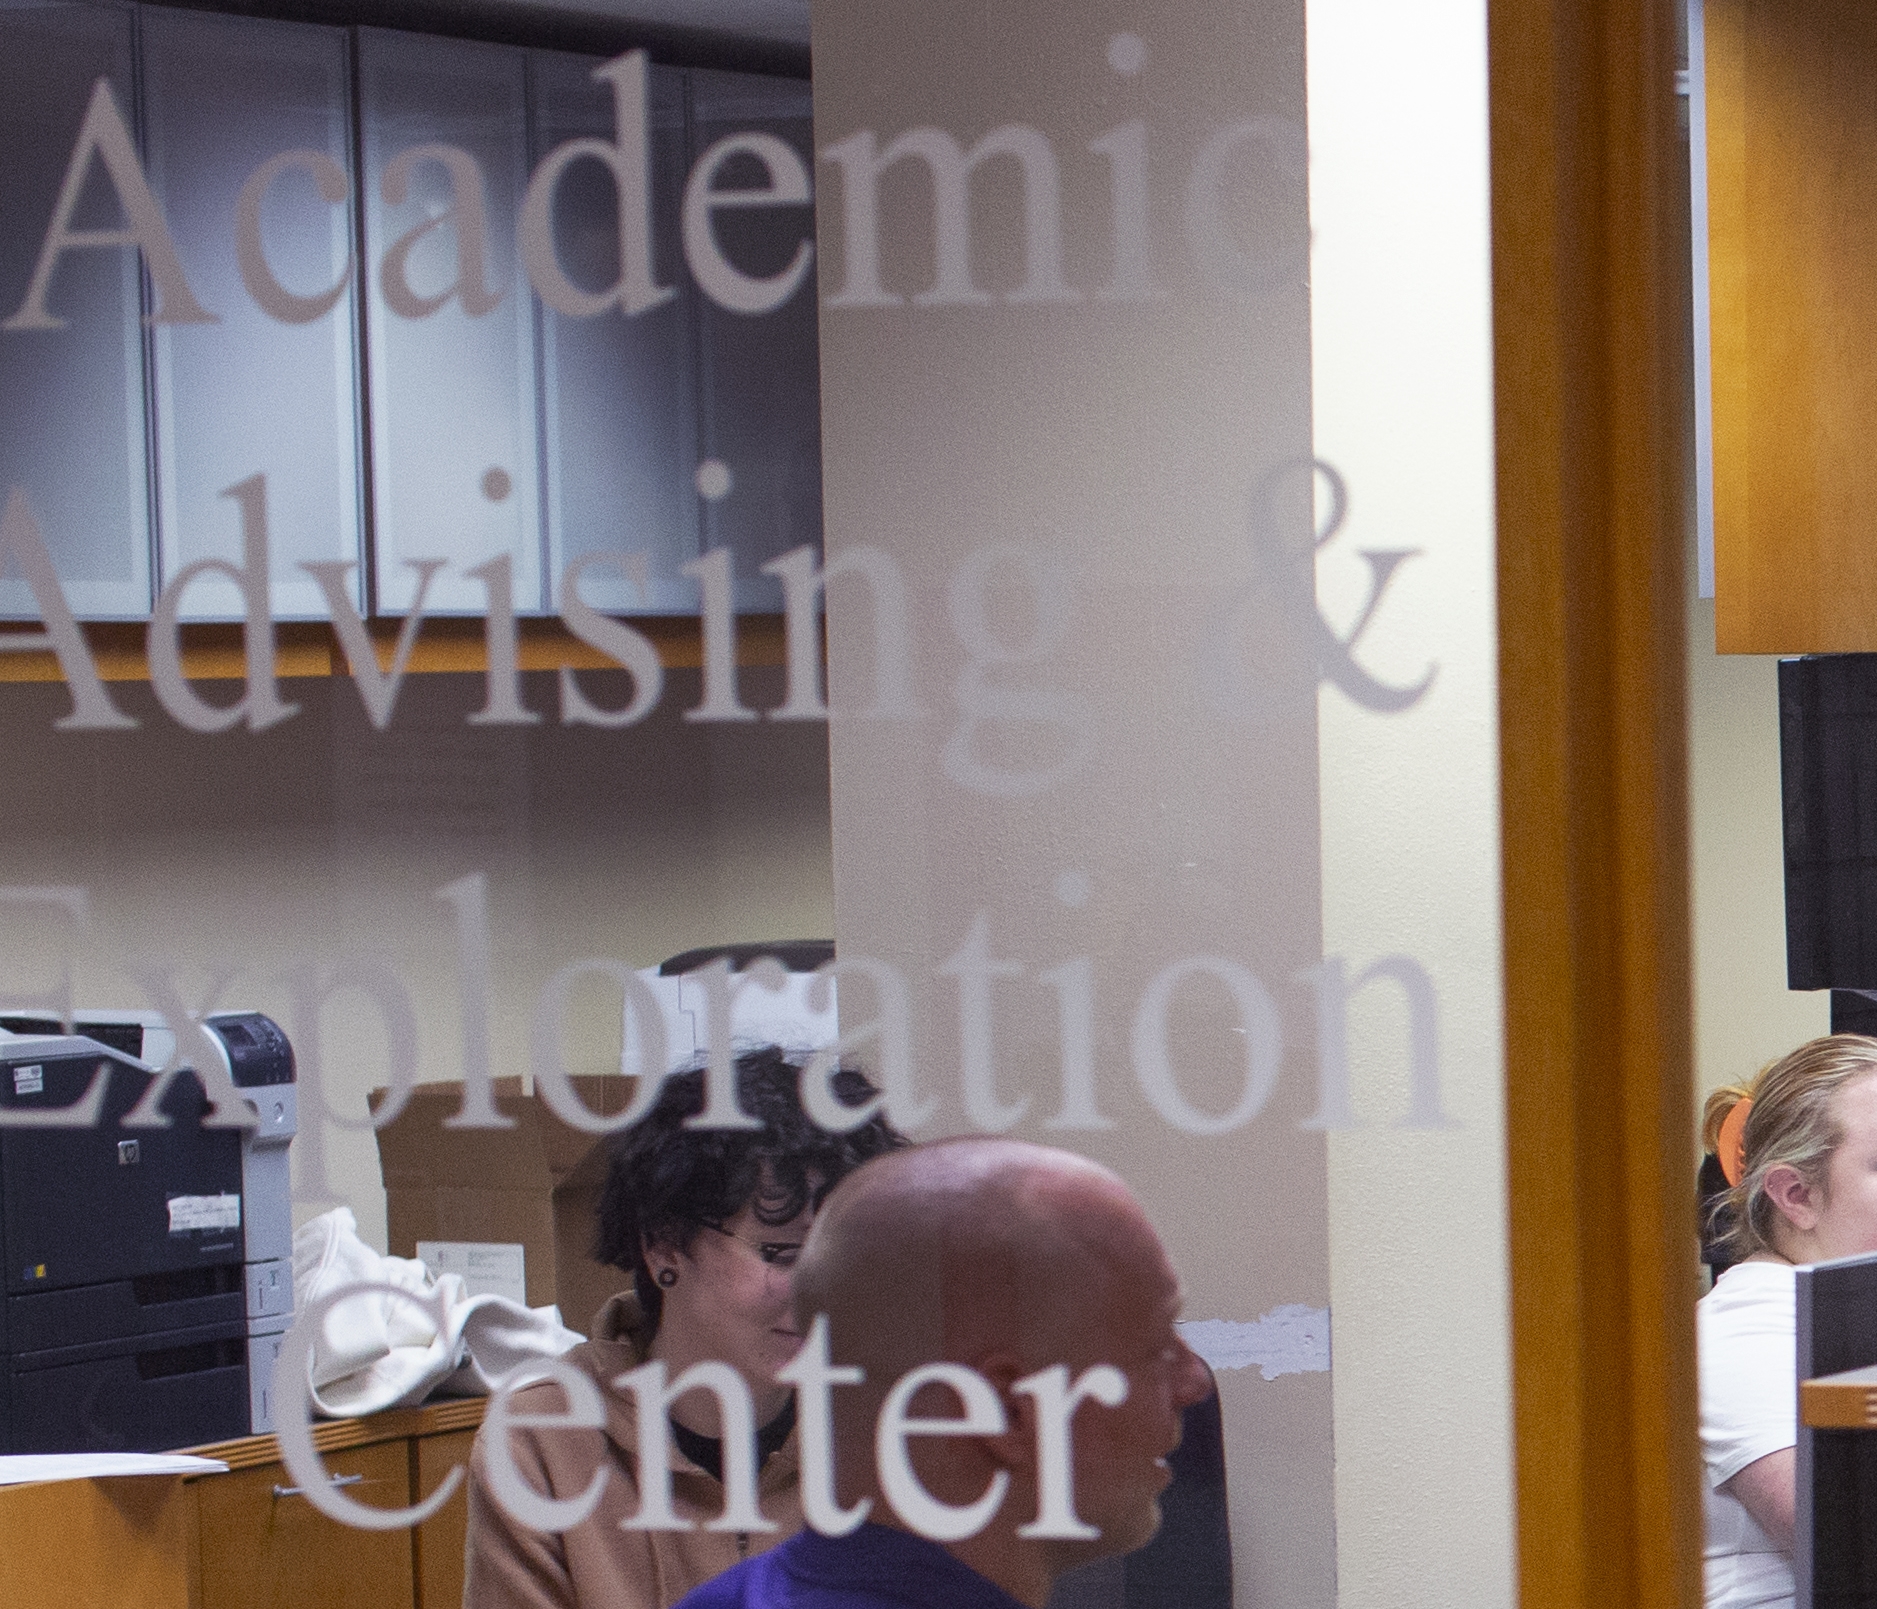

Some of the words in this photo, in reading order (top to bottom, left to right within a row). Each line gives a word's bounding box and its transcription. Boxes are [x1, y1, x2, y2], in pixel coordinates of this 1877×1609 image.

[2, 32, 1318, 330] Academic
[0, 460, 1090, 792] Advising
[1200, 456, 1440, 714] &
[274, 1278, 1130, 1542] Center
